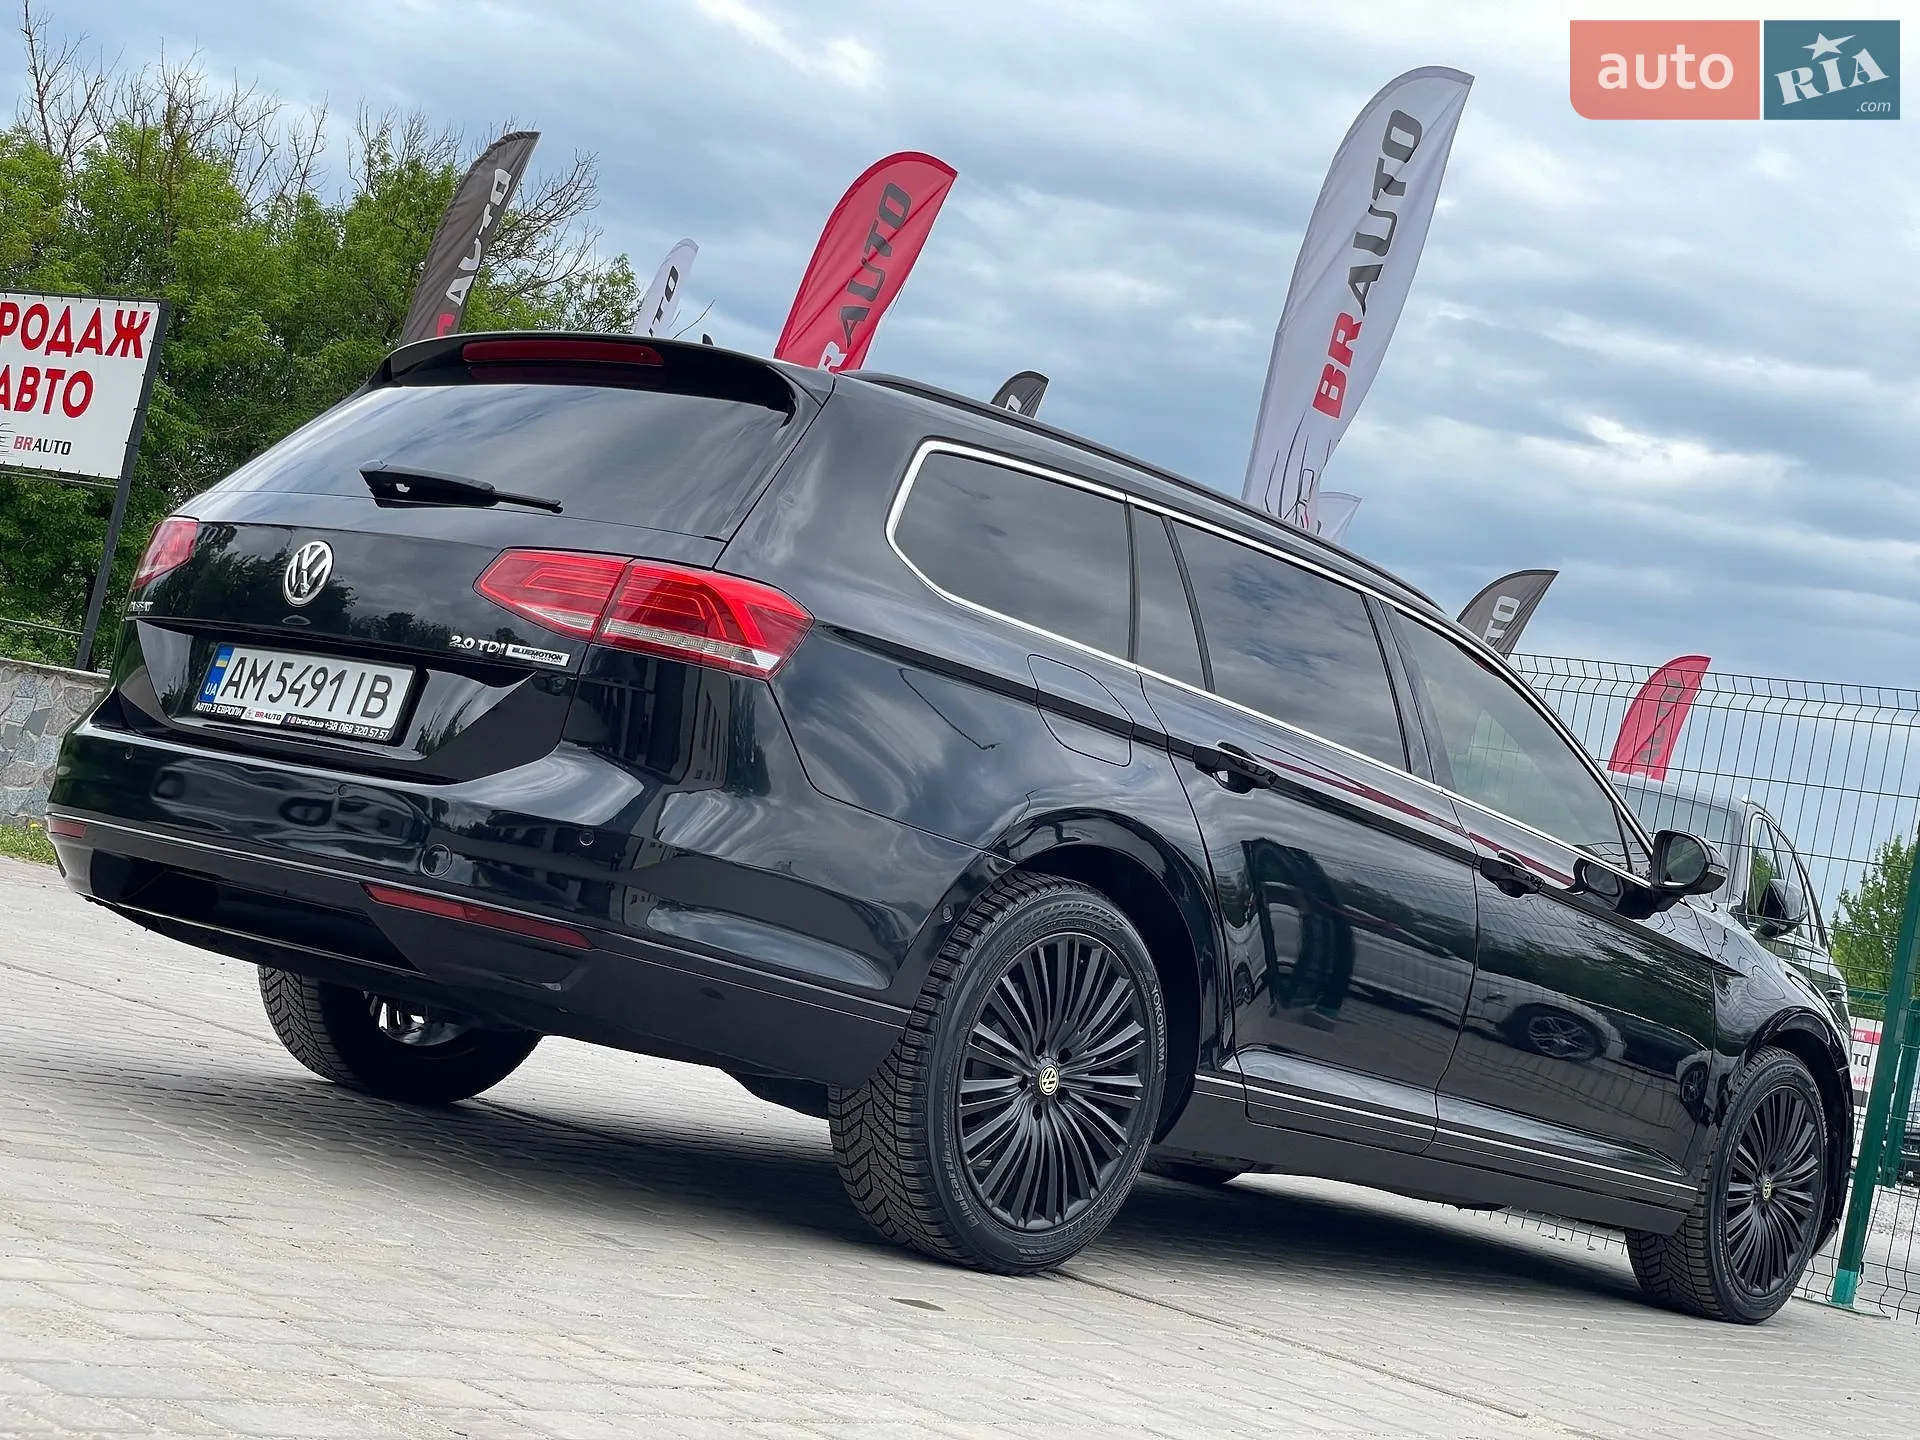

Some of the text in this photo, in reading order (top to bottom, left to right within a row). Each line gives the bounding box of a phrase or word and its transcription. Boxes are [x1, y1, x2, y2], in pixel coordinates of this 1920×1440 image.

[1312, 108, 1423, 419] BRAUTO
[0, 364, 94, 419] АВТО
[13, 436, 72, 456] BRAUTO
[205, 682, 217, 696] UA
[1151, 984, 1165, 1073] YOKOHAMA
